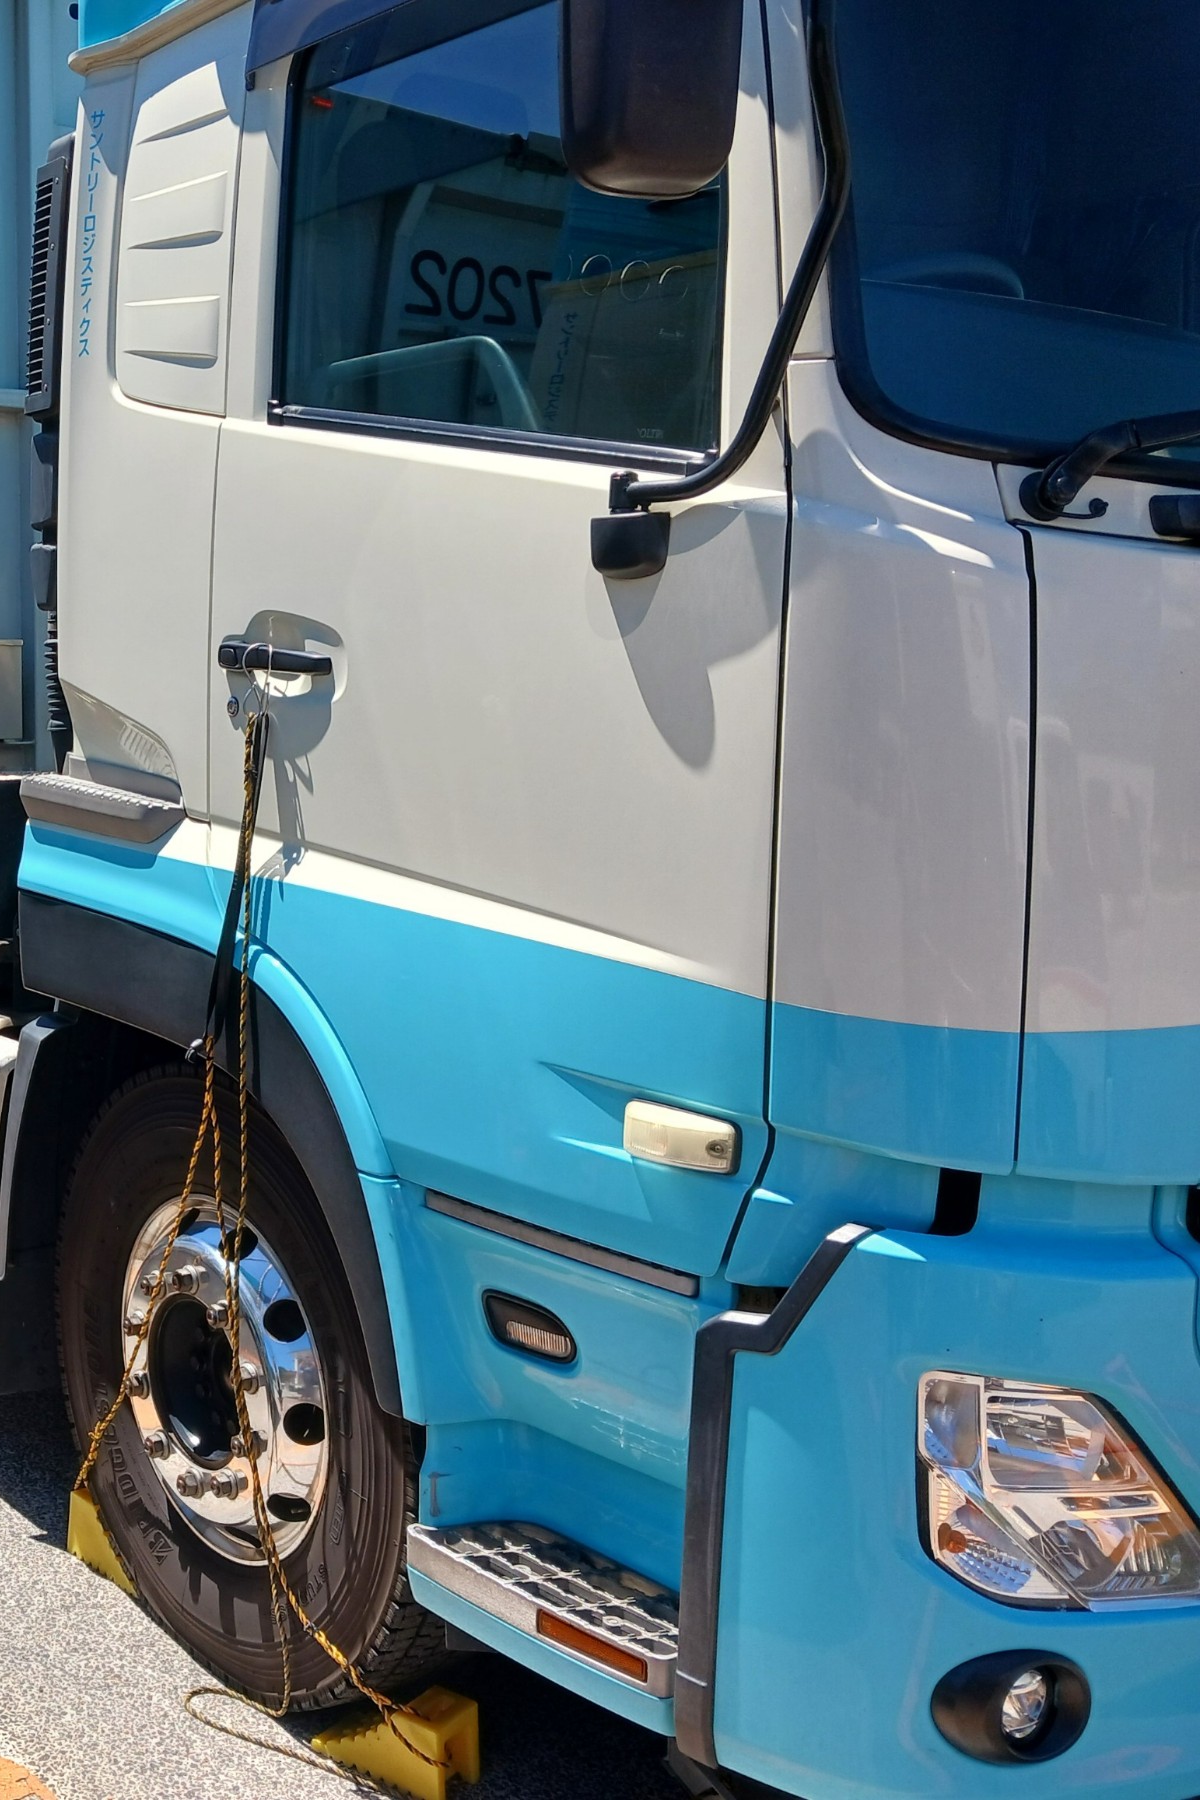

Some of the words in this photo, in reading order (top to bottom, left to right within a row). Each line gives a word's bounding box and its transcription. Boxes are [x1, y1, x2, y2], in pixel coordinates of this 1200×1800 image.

[78, 109, 106, 358] サントリーロジスティクス
